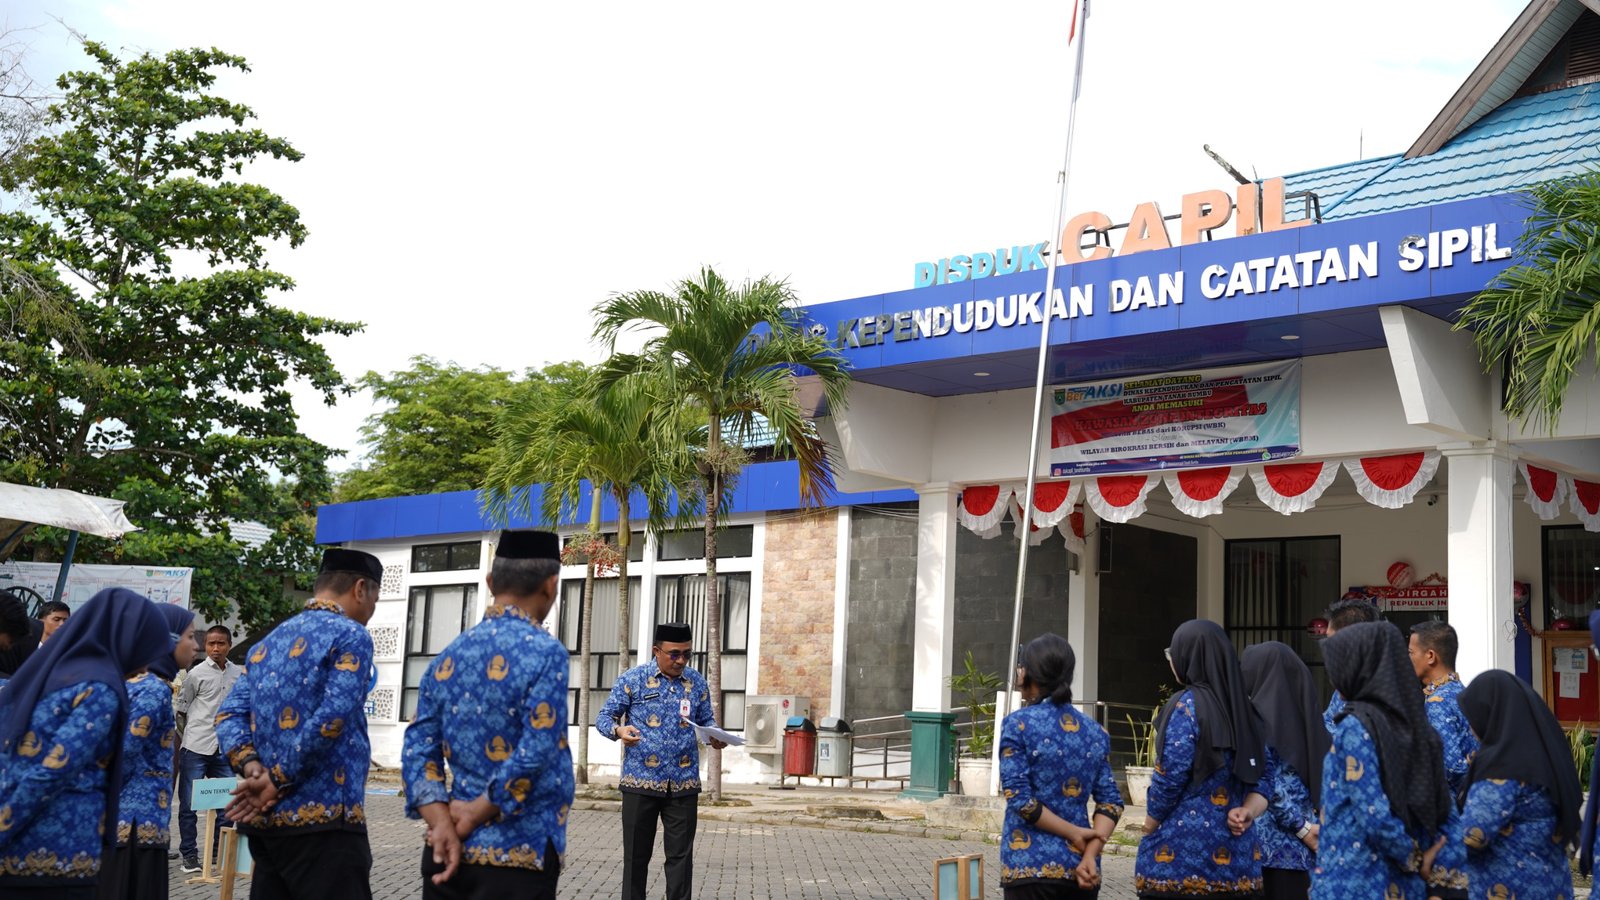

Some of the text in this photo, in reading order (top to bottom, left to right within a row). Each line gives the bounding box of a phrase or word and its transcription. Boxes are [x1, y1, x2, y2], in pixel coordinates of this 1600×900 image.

[914, 176, 1312, 288] DISDUK CAPIL
[837, 283, 1094, 349] KEPENDUDUKAN
[1109, 271, 1184, 313] DAN
[1200, 241, 1379, 299] CATATAN
[1399, 223, 1512, 272] SIPIL
[1124, 375, 1201, 389] SELAMAT DATANG
[1132, 399, 1204, 412] ANDA MEMASUKI
[1171, 423, 1202, 432] KORUPSI
[1176, 438, 1190, 448] dan
